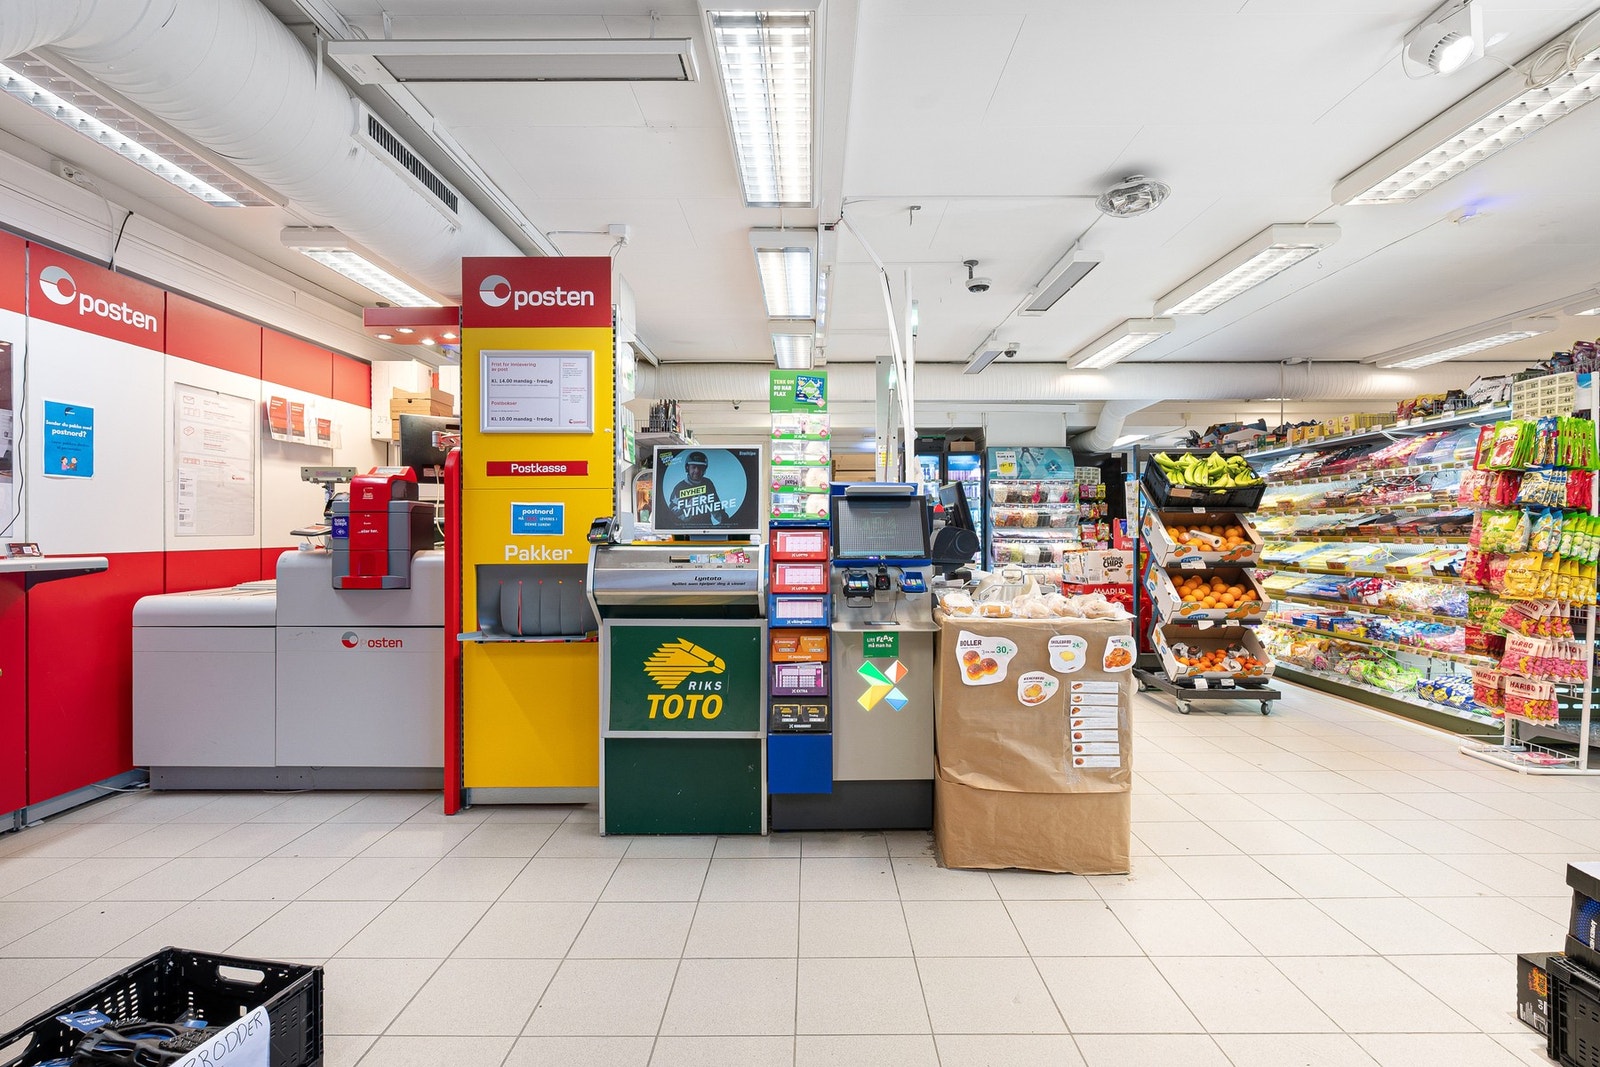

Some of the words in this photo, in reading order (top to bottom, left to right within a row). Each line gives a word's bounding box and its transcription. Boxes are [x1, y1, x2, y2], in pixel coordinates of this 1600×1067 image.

[514, 286, 595, 310] posten
[79, 292, 157, 333] posten
[51, 428, 87, 438] postnord?
[511, 463, 567, 474] Postkasse
[680, 486, 705, 497] NYHET
[677, 493, 715, 510] FLERE
[683, 498, 736, 518] VINNERE
[505, 544, 574, 561] Pakker
[1102, 560, 1124, 568] CHIPS
[876, 634, 894, 643] FLAX
[960, 639, 983, 647] BOLLER
[996, 645, 1013, 655] 30,-
[688, 681, 723, 691] RIKS
[1509, 681, 1536, 692] HARIBO
[647, 693, 723, 720] TOTO
